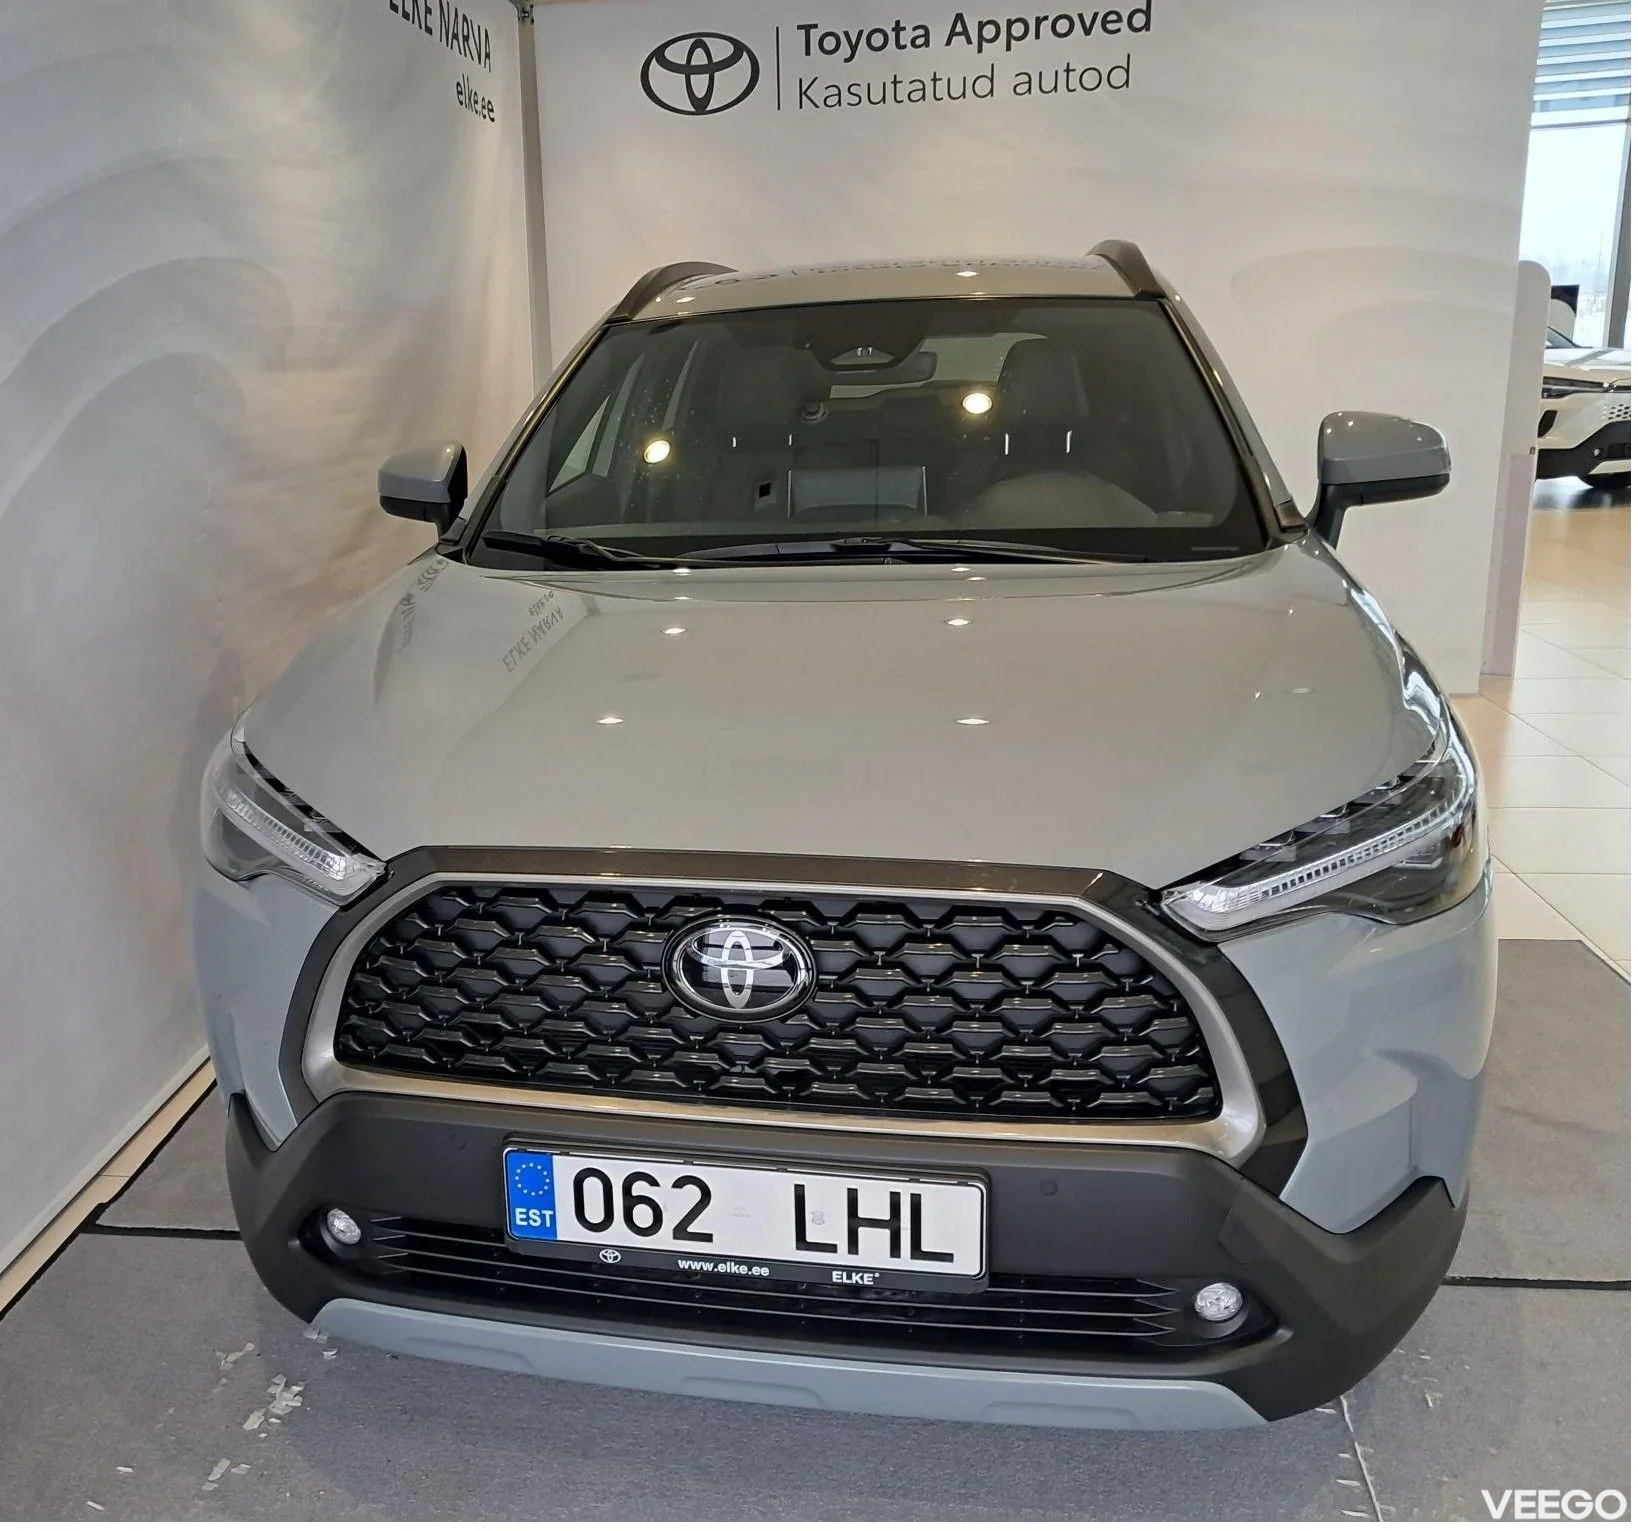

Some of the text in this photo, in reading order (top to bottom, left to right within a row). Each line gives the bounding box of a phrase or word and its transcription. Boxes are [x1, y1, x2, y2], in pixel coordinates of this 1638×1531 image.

[390, 0, 491, 72] KE NARVA
[797, 0, 1152, 63] Toyota Approved
[456, 72, 495, 122] elke.ee
[799, 53, 1132, 109] Kasutatud autod
[515, 1208, 553, 1227] EST
[573, 1167, 954, 1262] 062 LHL
[677, 1259, 770, 1276] www.elke.ee
